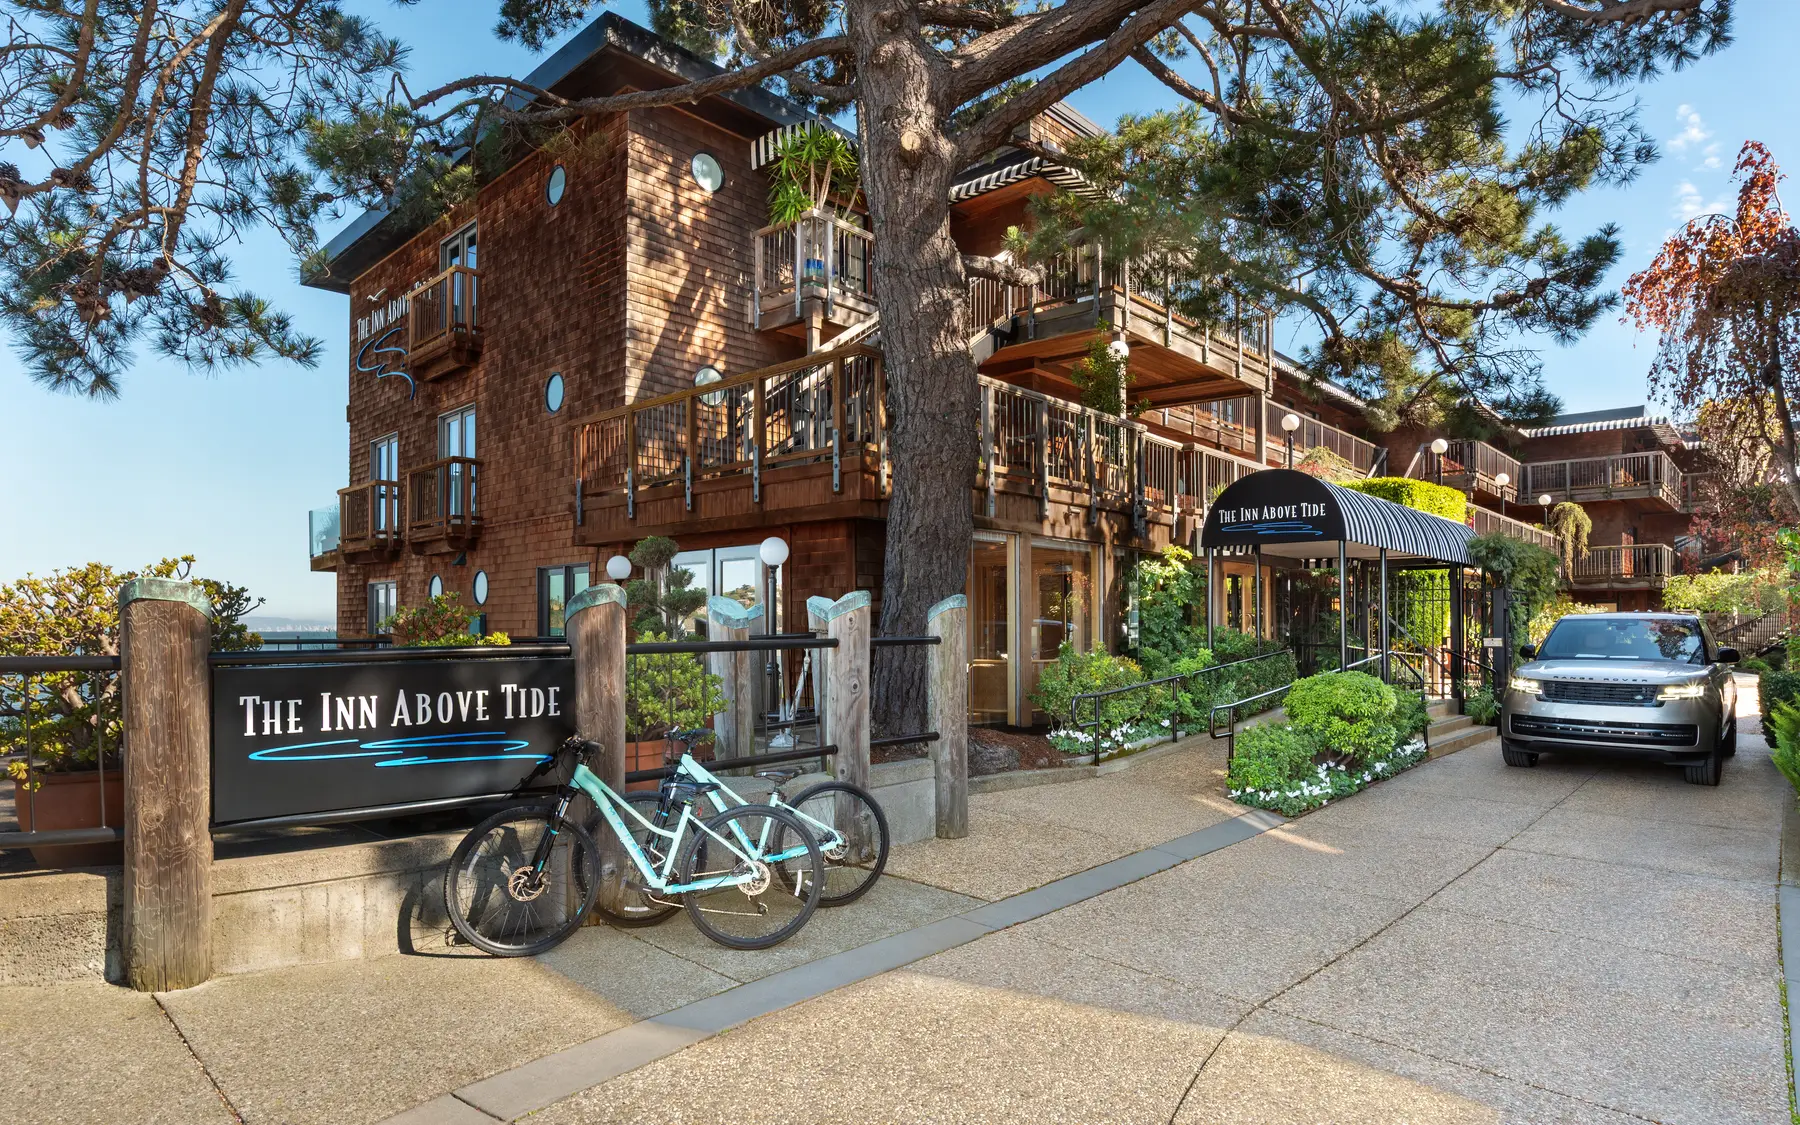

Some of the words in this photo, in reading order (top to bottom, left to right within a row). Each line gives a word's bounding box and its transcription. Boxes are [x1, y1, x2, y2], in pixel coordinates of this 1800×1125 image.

[357, 316, 370, 343] THE
[371, 307, 386, 335] INN
[1218, 509, 1237, 524] THE
[1240, 507, 1259, 522] INN
[1262, 505, 1298, 520] ABOVE
[1300, 502, 1326, 518] TIDE
[239, 695, 304, 737] THE
[320, 692, 378, 732] INN
[391, 688, 490, 727] ABOVE
[501, 683, 561, 719] TIDE
